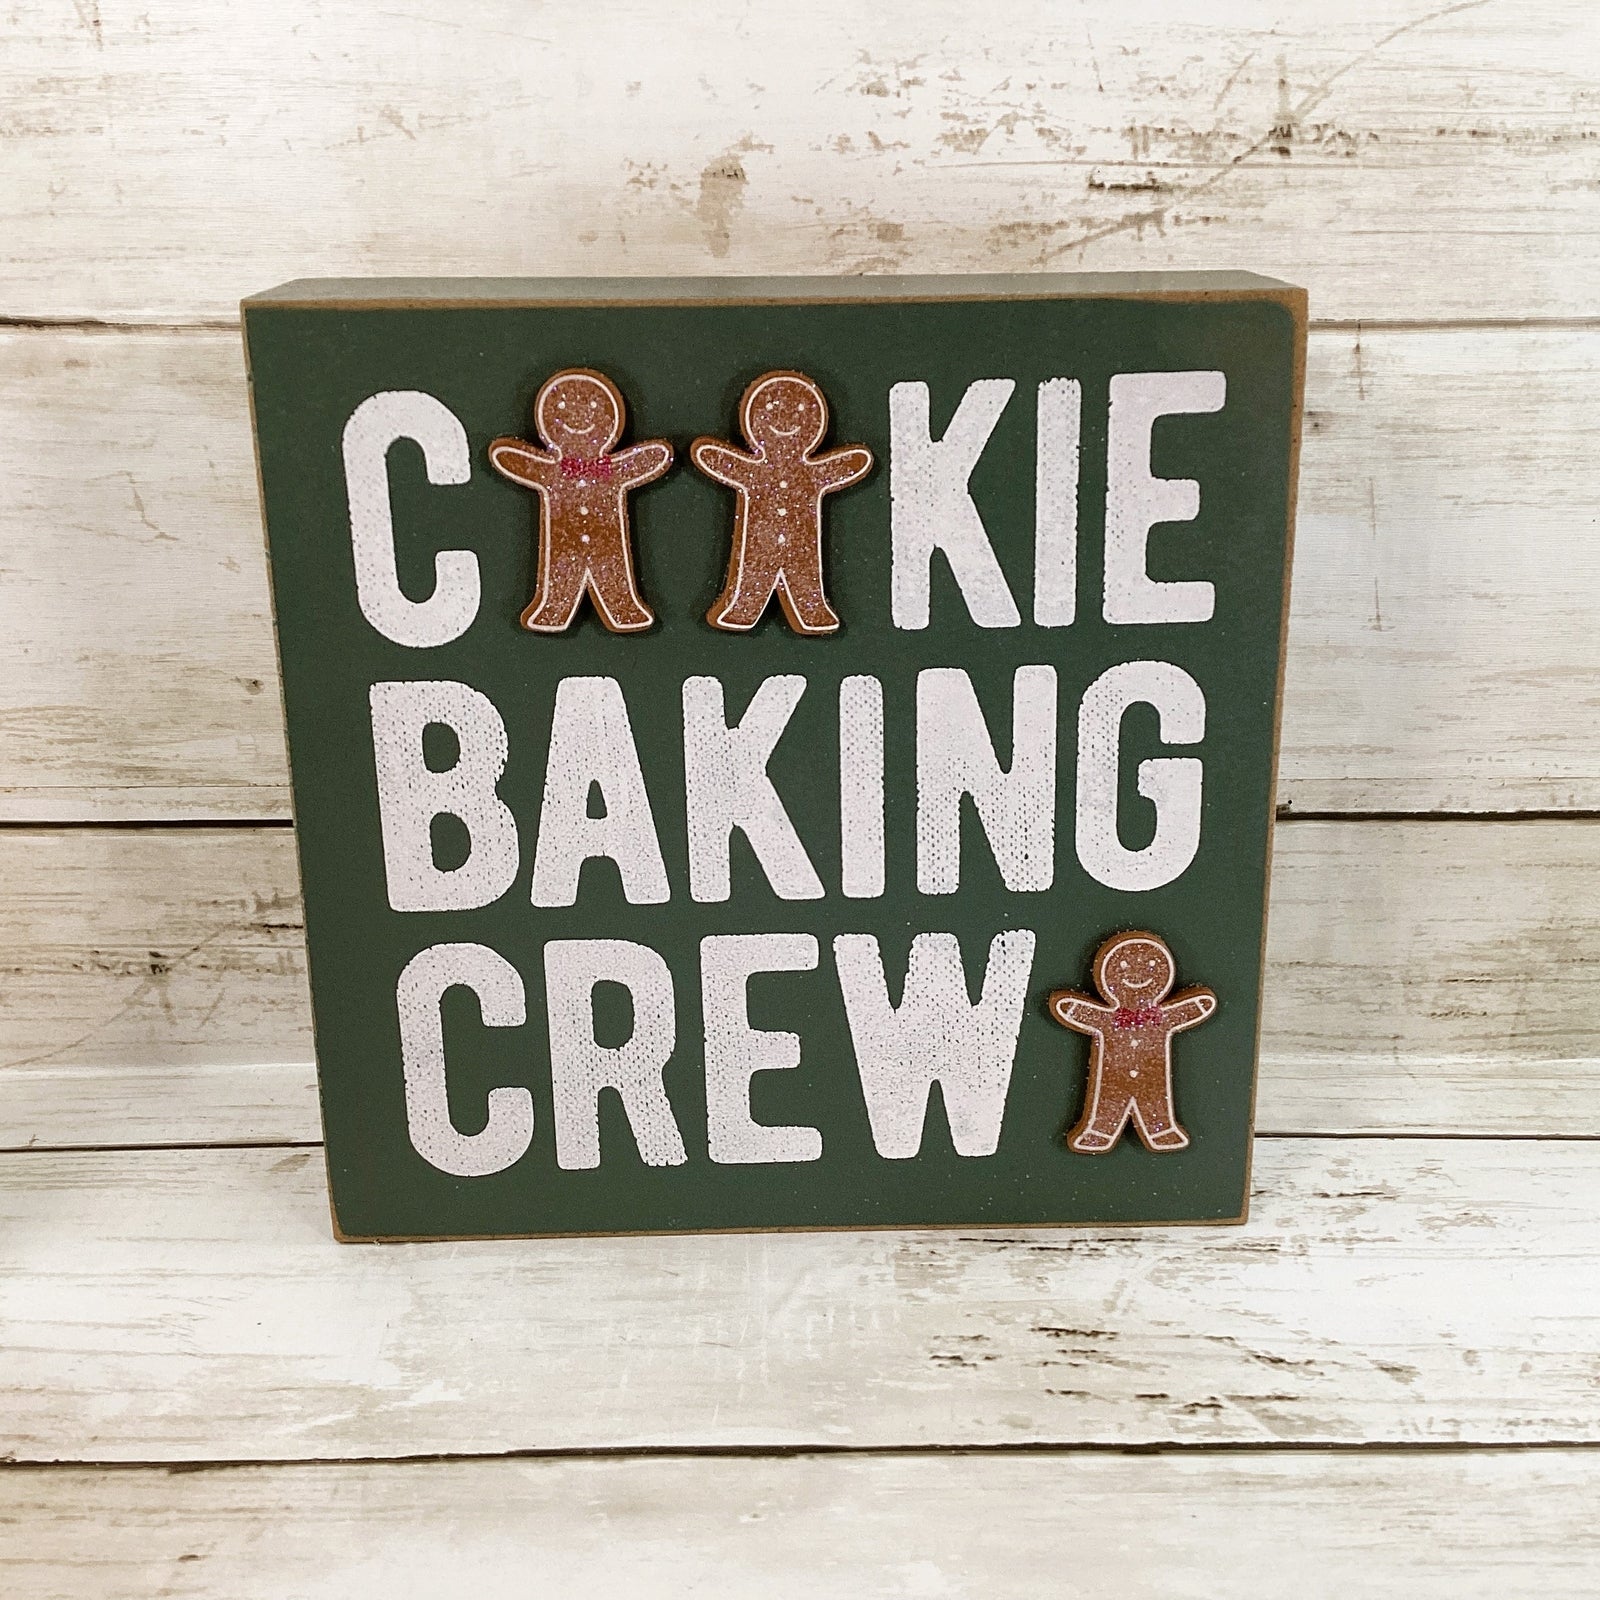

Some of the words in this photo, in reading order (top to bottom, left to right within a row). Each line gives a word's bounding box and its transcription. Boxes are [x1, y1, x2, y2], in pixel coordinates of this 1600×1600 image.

[342, 368, 1227, 648] CKIE
[369, 660, 1207, 913] BAKING
[396, 928, 1037, 1178] CREW
